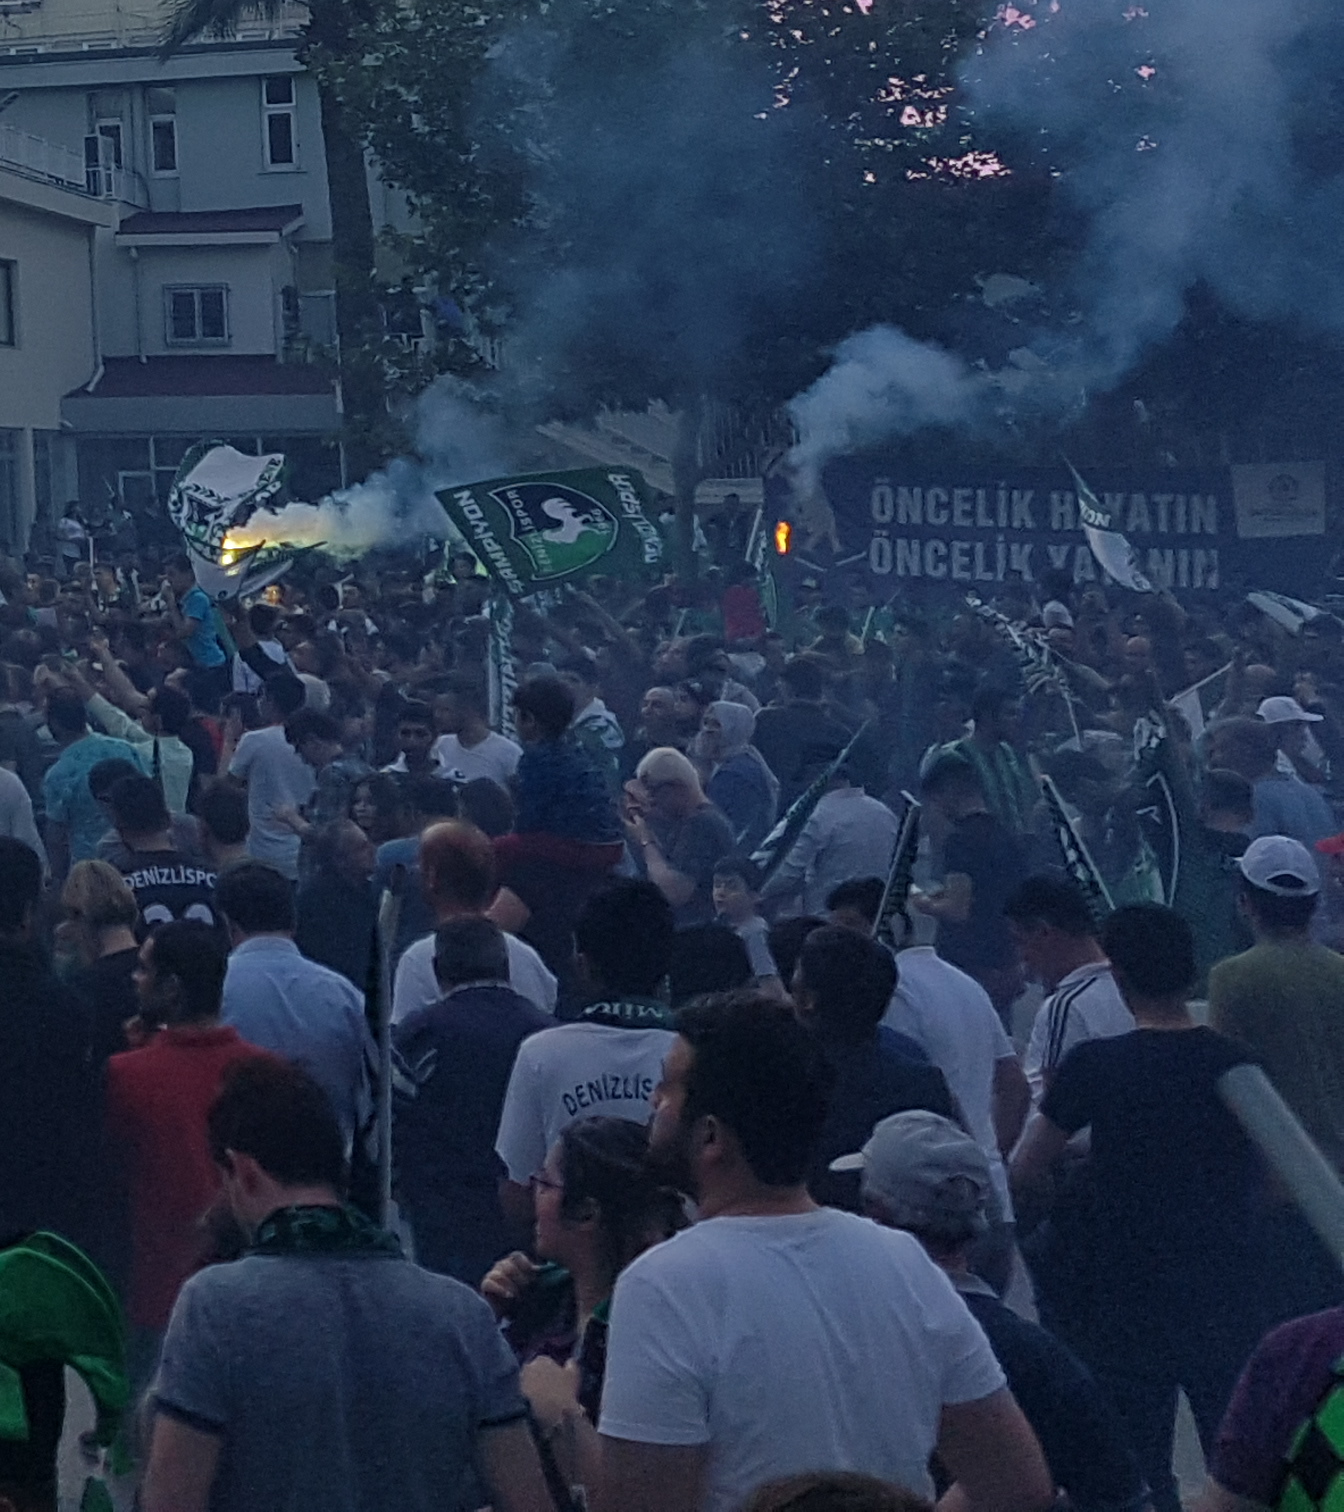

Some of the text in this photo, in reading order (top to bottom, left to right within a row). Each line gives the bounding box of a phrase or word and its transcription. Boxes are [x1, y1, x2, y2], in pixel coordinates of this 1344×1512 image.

[870, 476, 1218, 534] ÖNCELİK HYATIN
[869, 529, 1219, 589] ÖNCELİK YANIN
